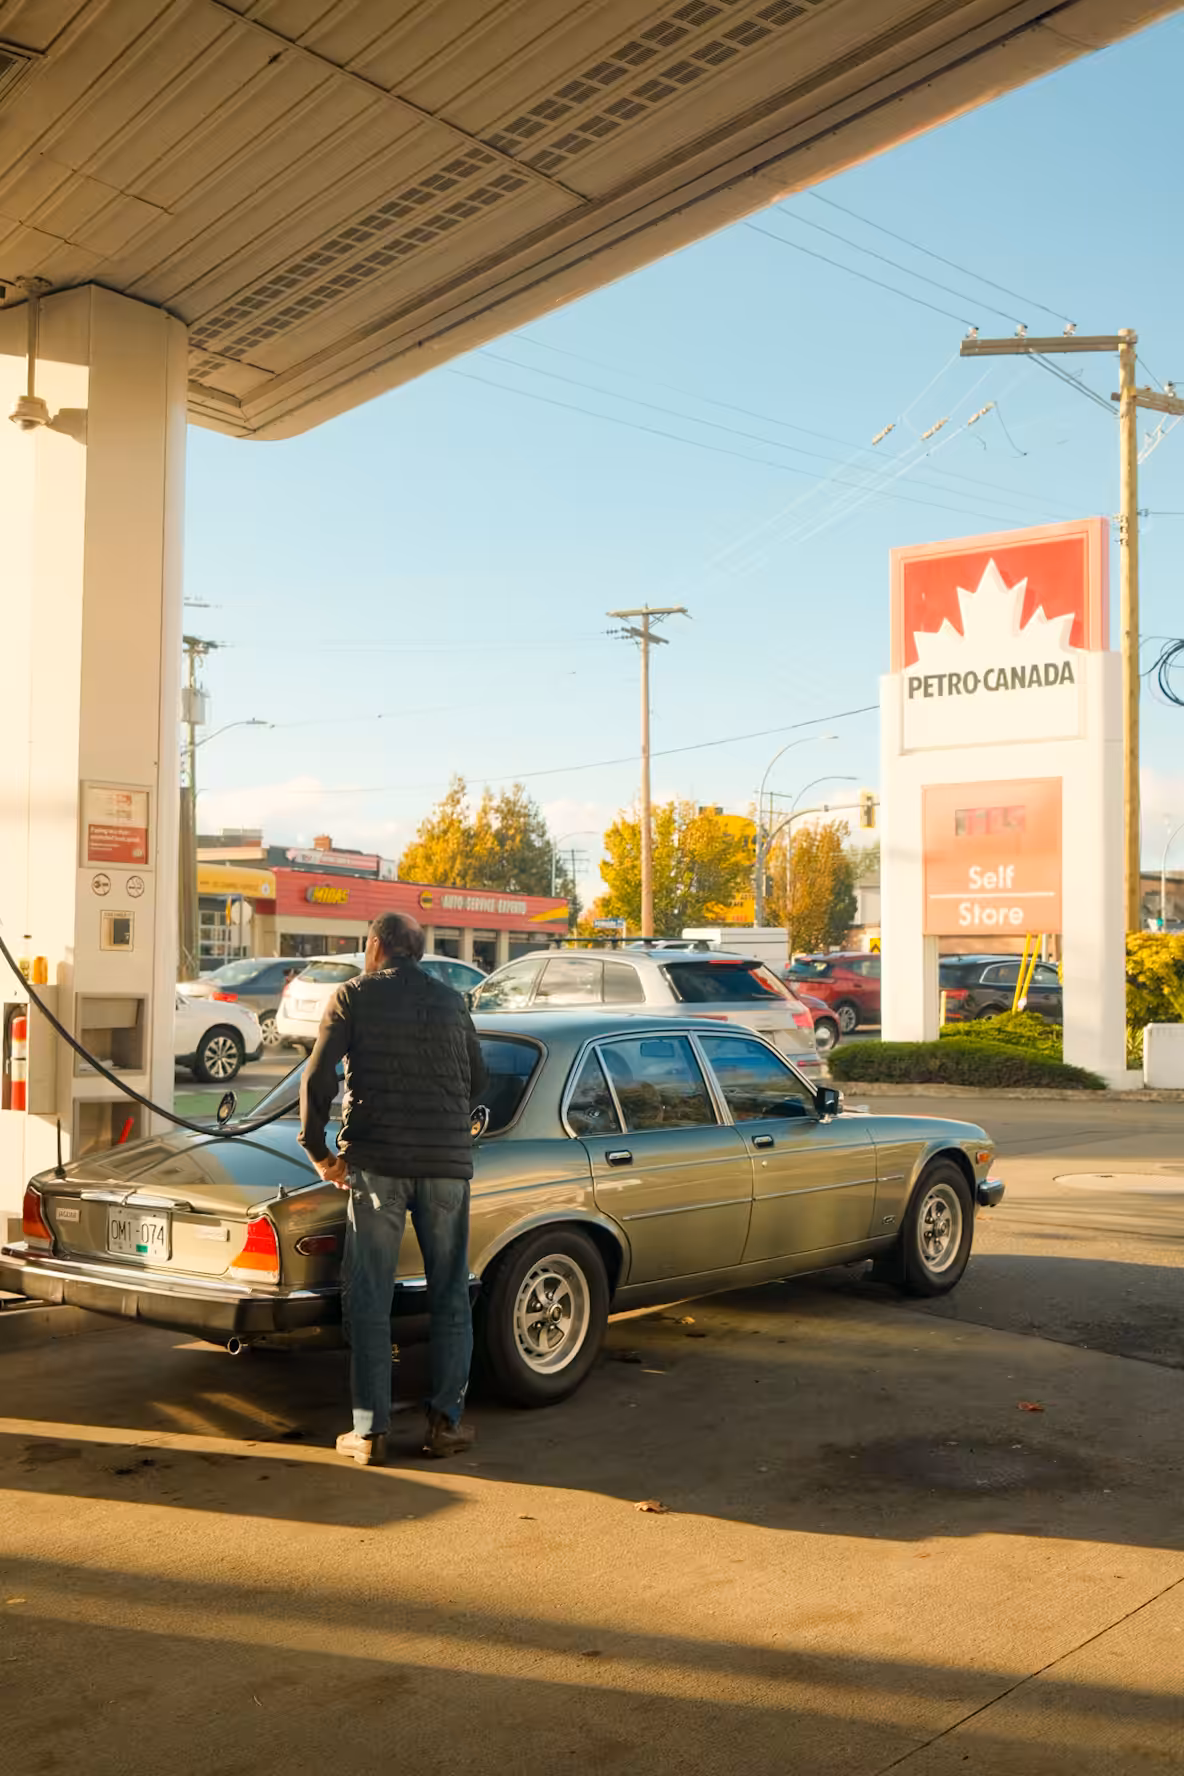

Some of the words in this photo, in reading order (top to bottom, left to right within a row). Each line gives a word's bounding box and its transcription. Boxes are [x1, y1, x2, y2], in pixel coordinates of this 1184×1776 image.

[968, 864, 1015, 889] Self
[313, 886, 350, 905] MIDAS
[441, 895, 464, 910] AUTO
[466, 896, 496, 913] SERVICE
[958, 901, 1025, 926] Store
